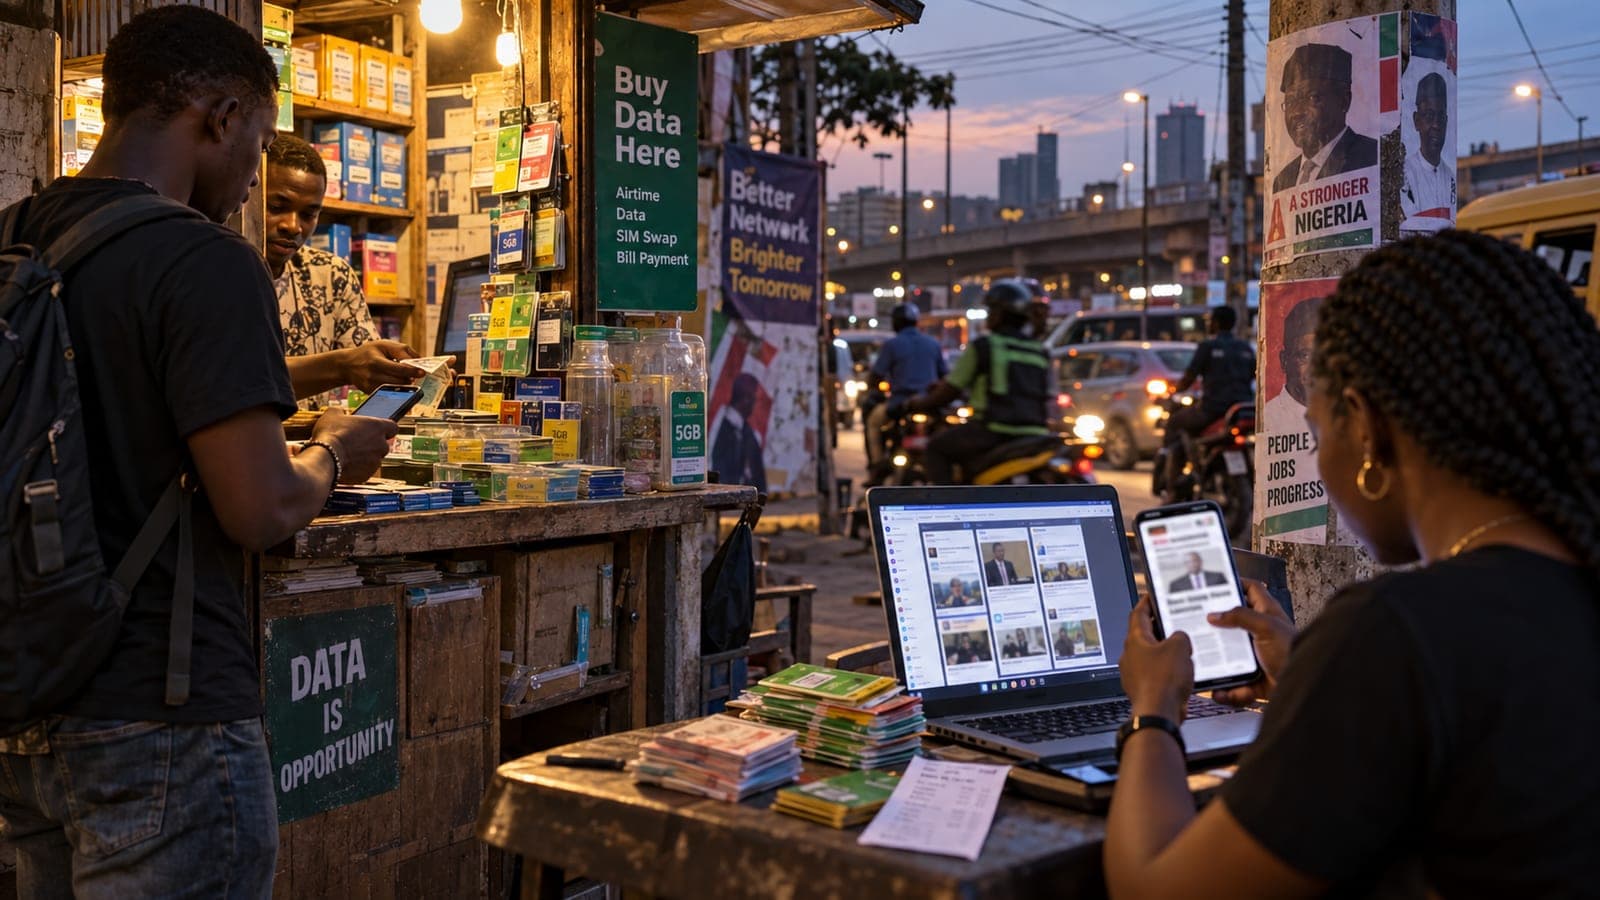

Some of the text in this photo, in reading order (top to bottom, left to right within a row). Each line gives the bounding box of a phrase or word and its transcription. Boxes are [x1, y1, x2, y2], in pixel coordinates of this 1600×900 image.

[615, 65, 669, 105] Buy
[615, 101, 681, 136] Data
[615, 135, 681, 168] Here
[616, 186, 660, 202] Airtime
[731, 169, 795, 211] Better
[1289, 177, 1369, 212] A STRONGER
[616, 207, 646, 222] Data
[730, 203, 809, 244] Network
[1295, 199, 1368, 235] NIGERIA
[616, 229, 677, 248] SIM Swap
[730, 237, 804, 273] Brighter
[617, 251, 689, 268] Bill Payment
[728, 267, 813, 302] Tomorrow
[675, 424, 701, 441] 5GB
[1267, 432, 1309, 455] PEOPLE
[1267, 459, 1296, 481] JOBS
[1267, 480, 1324, 508] PROGRESS
[290, 638, 367, 702] DATA
[323, 698, 343, 734] IS
[280, 718, 395, 793] OPPORTUNITY
